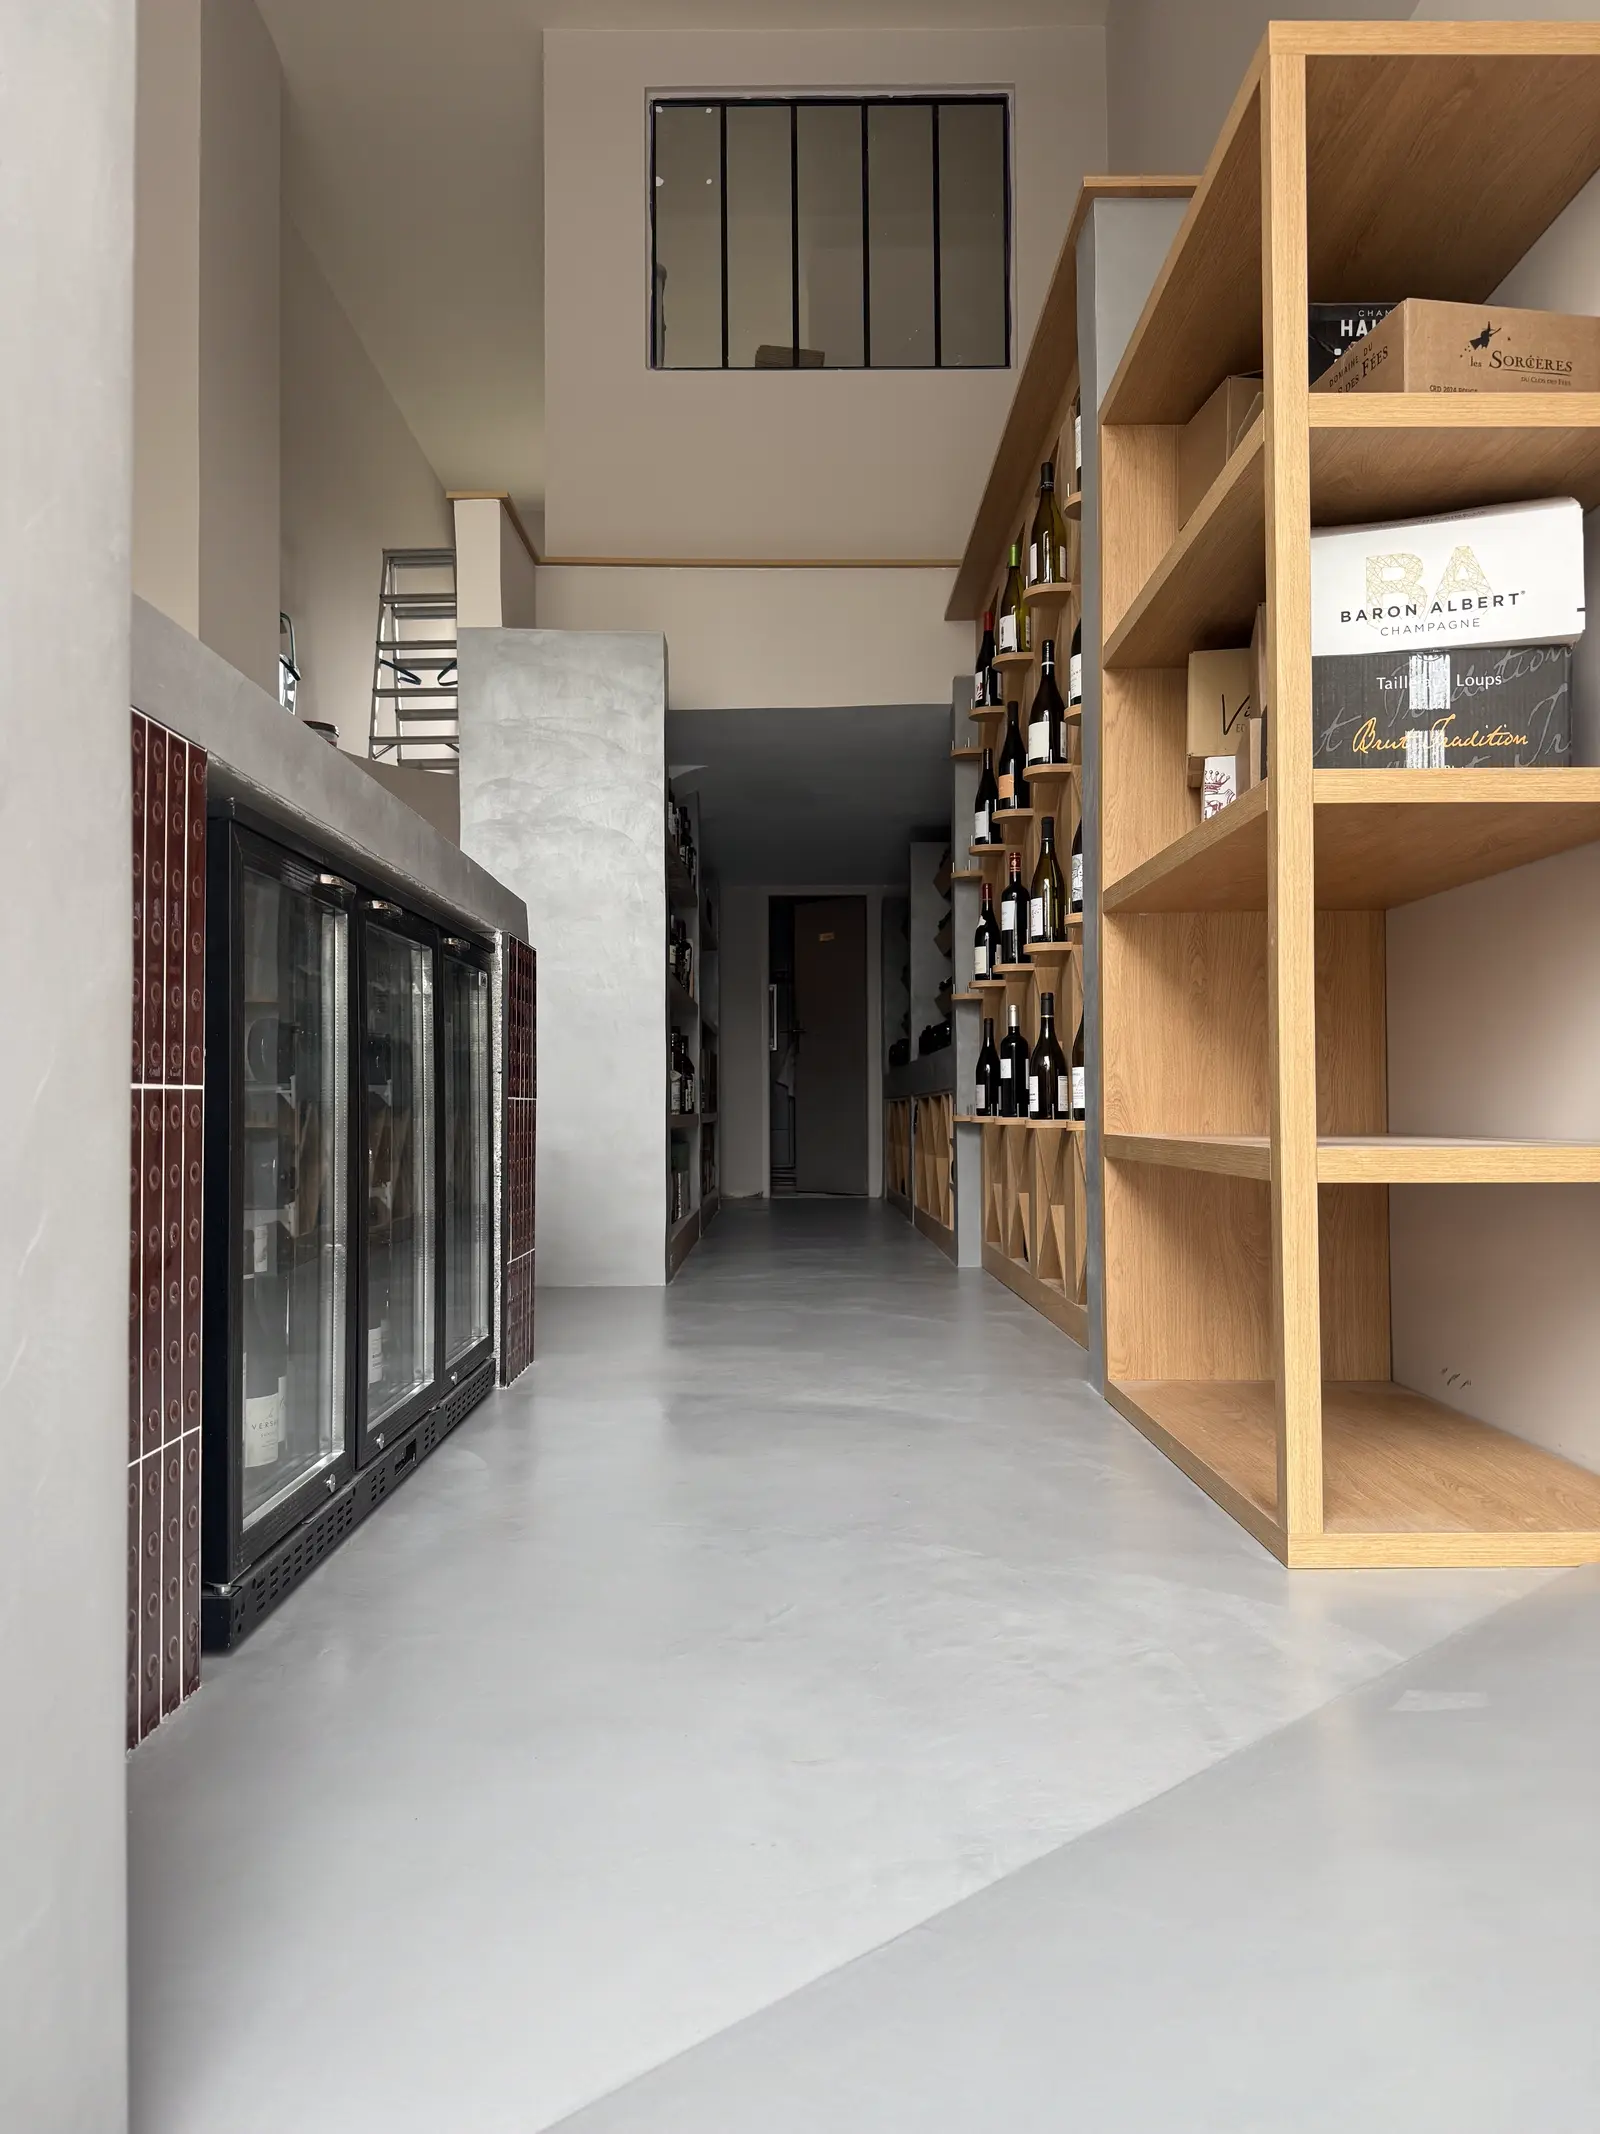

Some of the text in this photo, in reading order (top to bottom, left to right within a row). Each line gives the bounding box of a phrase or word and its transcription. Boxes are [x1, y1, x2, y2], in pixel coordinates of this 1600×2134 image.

[1340, 319, 1377, 337] HA
[1329, 355, 1359, 388] DOMAINE
[1363, 341, 1373, 357] DU
[1362, 345, 1389, 379] FÉES
[1470, 356, 1482, 368] les
[1340, 603, 1418, 624] BARON
[1380, 617, 1481, 637] CHAMPAGNE
[1456, 673, 1503, 690] Loups
[1423, 713, 1529, 751] Tradition
